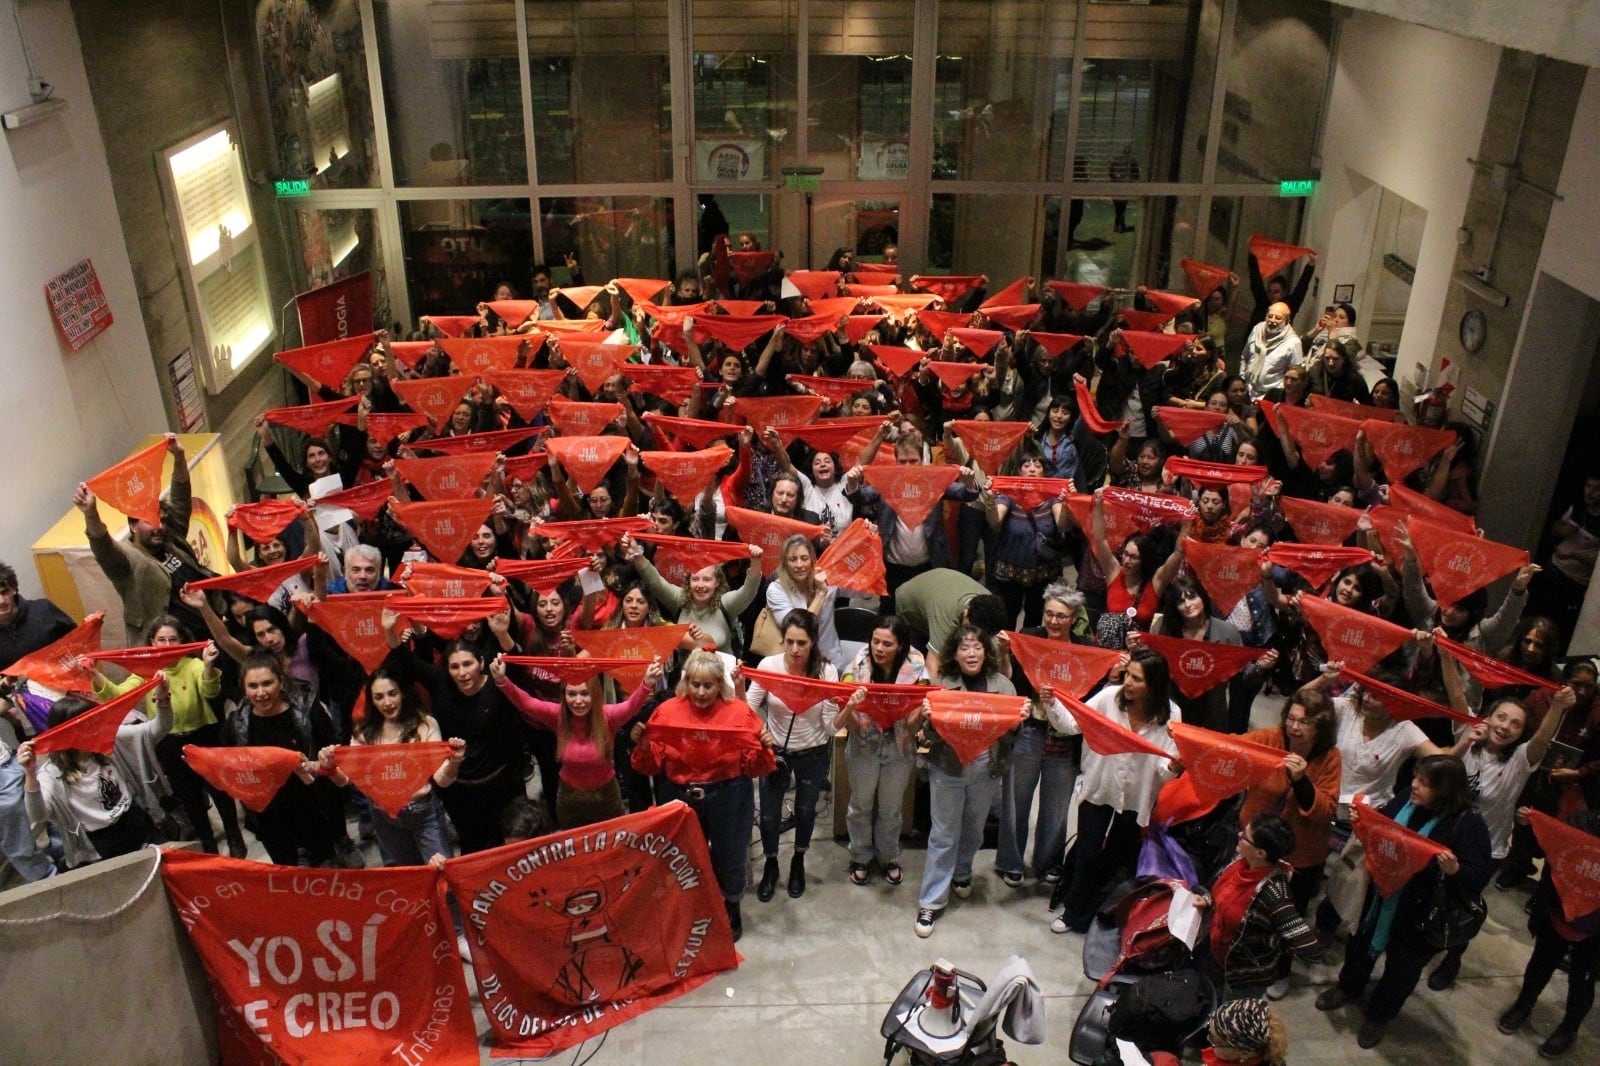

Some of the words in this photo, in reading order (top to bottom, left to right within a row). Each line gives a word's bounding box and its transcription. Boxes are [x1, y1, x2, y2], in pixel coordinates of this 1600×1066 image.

[276, 181, 309, 192] SALIDA
[1282, 180, 1312, 192] SALIDA
[506, 838, 576, 882] CONTRA
[583, 831, 608, 853] LA
[215, 881, 246, 900] en
[268, 872, 364, 900] Lucha
[226, 936, 303, 987] YO
[312, 912, 388, 982] SÍ
[674, 917, 712, 978] SEXUAL
[240, 999, 272, 1042] E
[284, 991, 400, 1038] CREO
[392, 984, 455, 1066] Infancias
[492, 996, 518, 1030] LOS
